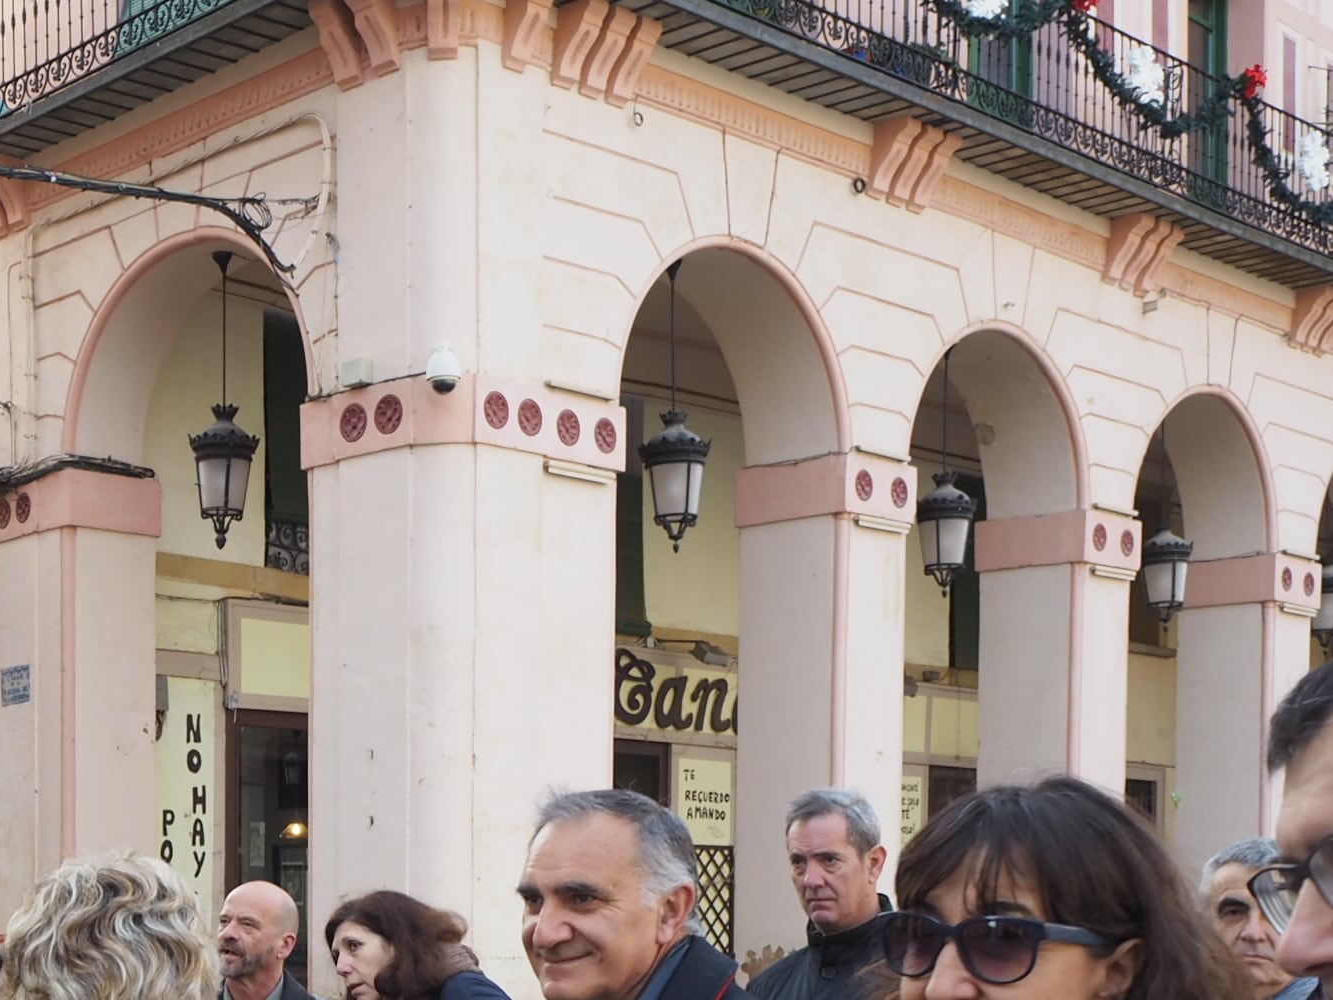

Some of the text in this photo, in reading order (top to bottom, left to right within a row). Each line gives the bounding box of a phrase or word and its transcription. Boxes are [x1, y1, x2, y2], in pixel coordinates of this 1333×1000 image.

[615, 648, 737, 735] Can
[186, 713, 206, 878] NO HAY
[683, 769, 695, 781] TE
